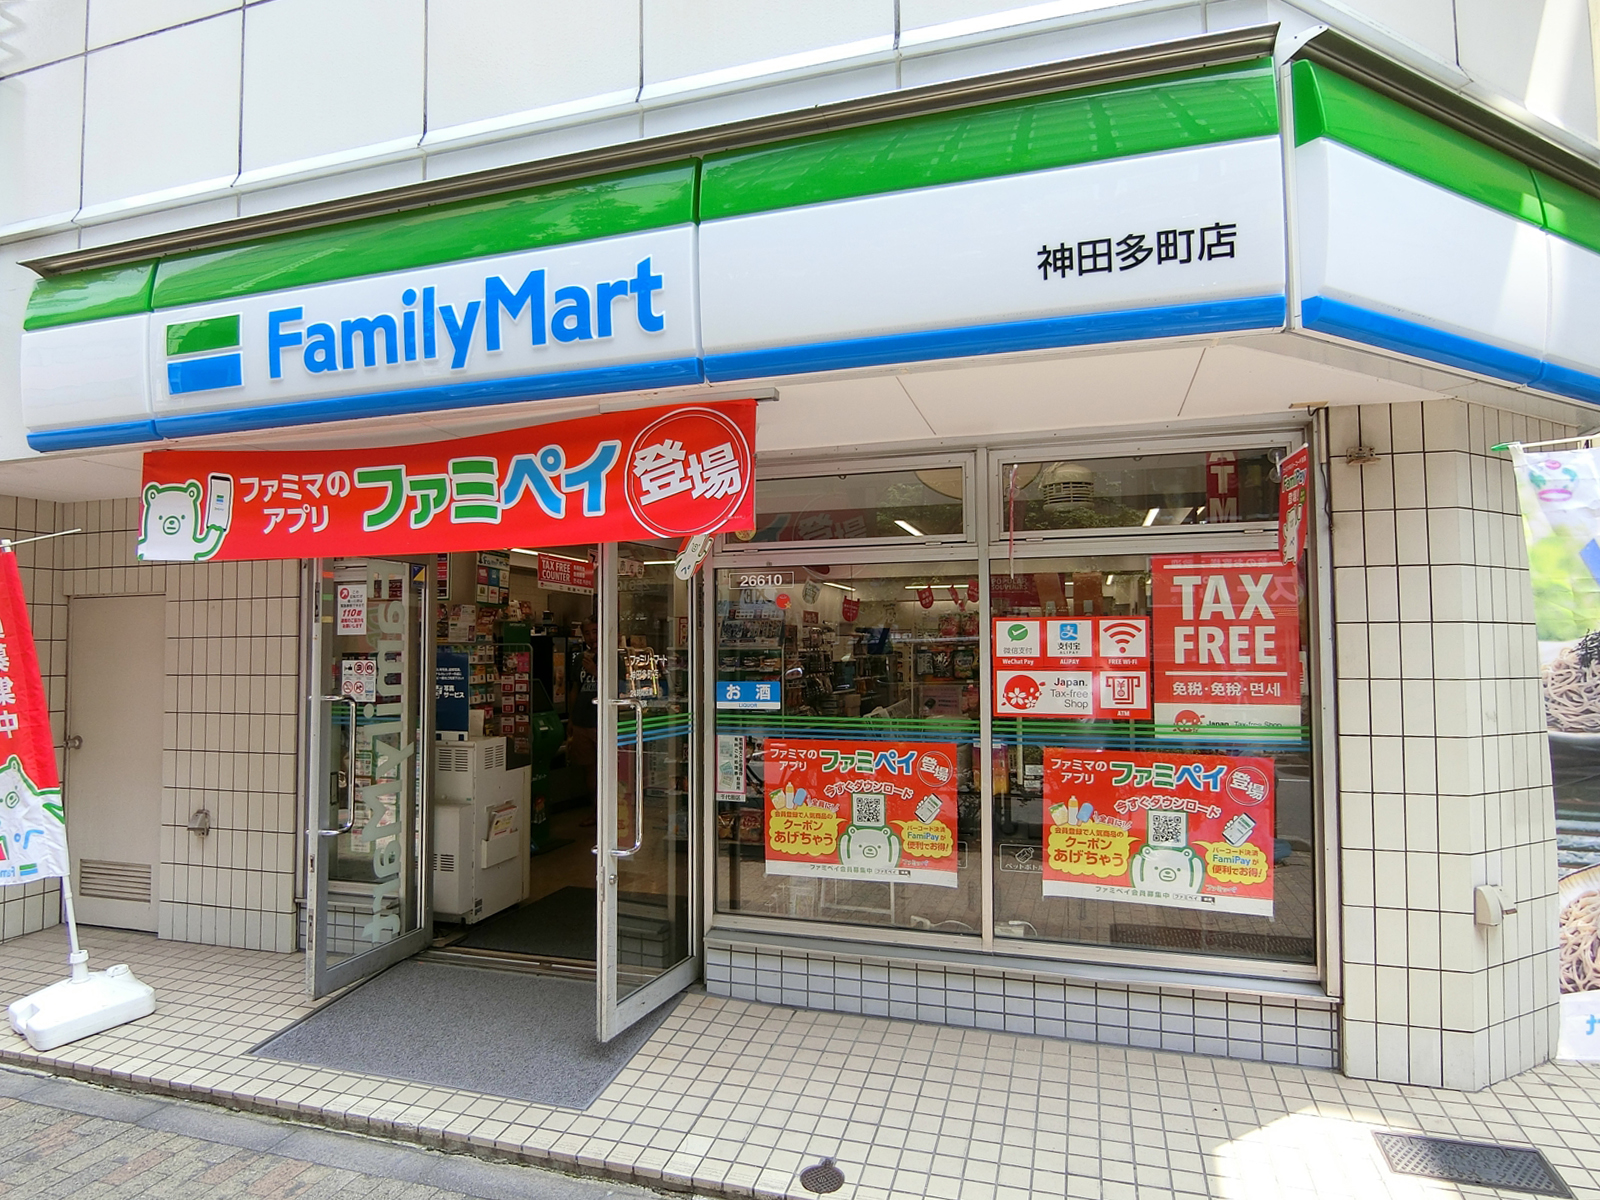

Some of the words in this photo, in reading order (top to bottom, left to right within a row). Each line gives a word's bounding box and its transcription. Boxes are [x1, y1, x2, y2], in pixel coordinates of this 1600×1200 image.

[1037, 222, 1237, 281] 神田多町店
[268, 255, 666, 380] FamilyMart
[632, 438, 744, 504] 登場
[240, 471, 351, 503] ファミマの
[352, 440, 622, 533] ファミペイ
[263, 503, 330, 535] アプリ
[542, 560, 555, 571] TAX
[555, 562, 571, 573] FREE
[542, 570, 571, 582] COUNTER
[740, 574, 783, 587] 26610
[1173, 574, 1276, 620] TAX
[1174, 625, 1277, 665] FREE
[1023, 658, 1034, 666] Pay
[1050, 689, 1088, 698] Tax-free
[1064, 699, 1088, 709] Shop
[770, 747, 817, 760] ファミマの
[819, 750, 917, 776] ファミペイ
[779, 760, 807, 772] アプリ
[920, 756, 949, 782] 登場
[1051, 758, 1107, 772] ファミマの
[1061, 772, 1095, 785] アプリ
[1109, 761, 1228, 792] ファミペイ
[1230, 771, 1266, 801] 登場
[823, 780, 914, 800] 今すぐダウンロード
[1114, 795, 1221, 819] 今すぐダウンロード
[783, 819, 823, 831] クーポン
[774, 830, 834, 847] あげちゃう
[1065, 836, 1112, 850] クーポン
[1053, 848, 1124, 867] あげちゃう
[1095, 885, 1170, 899] ファミペイ会員募集中
